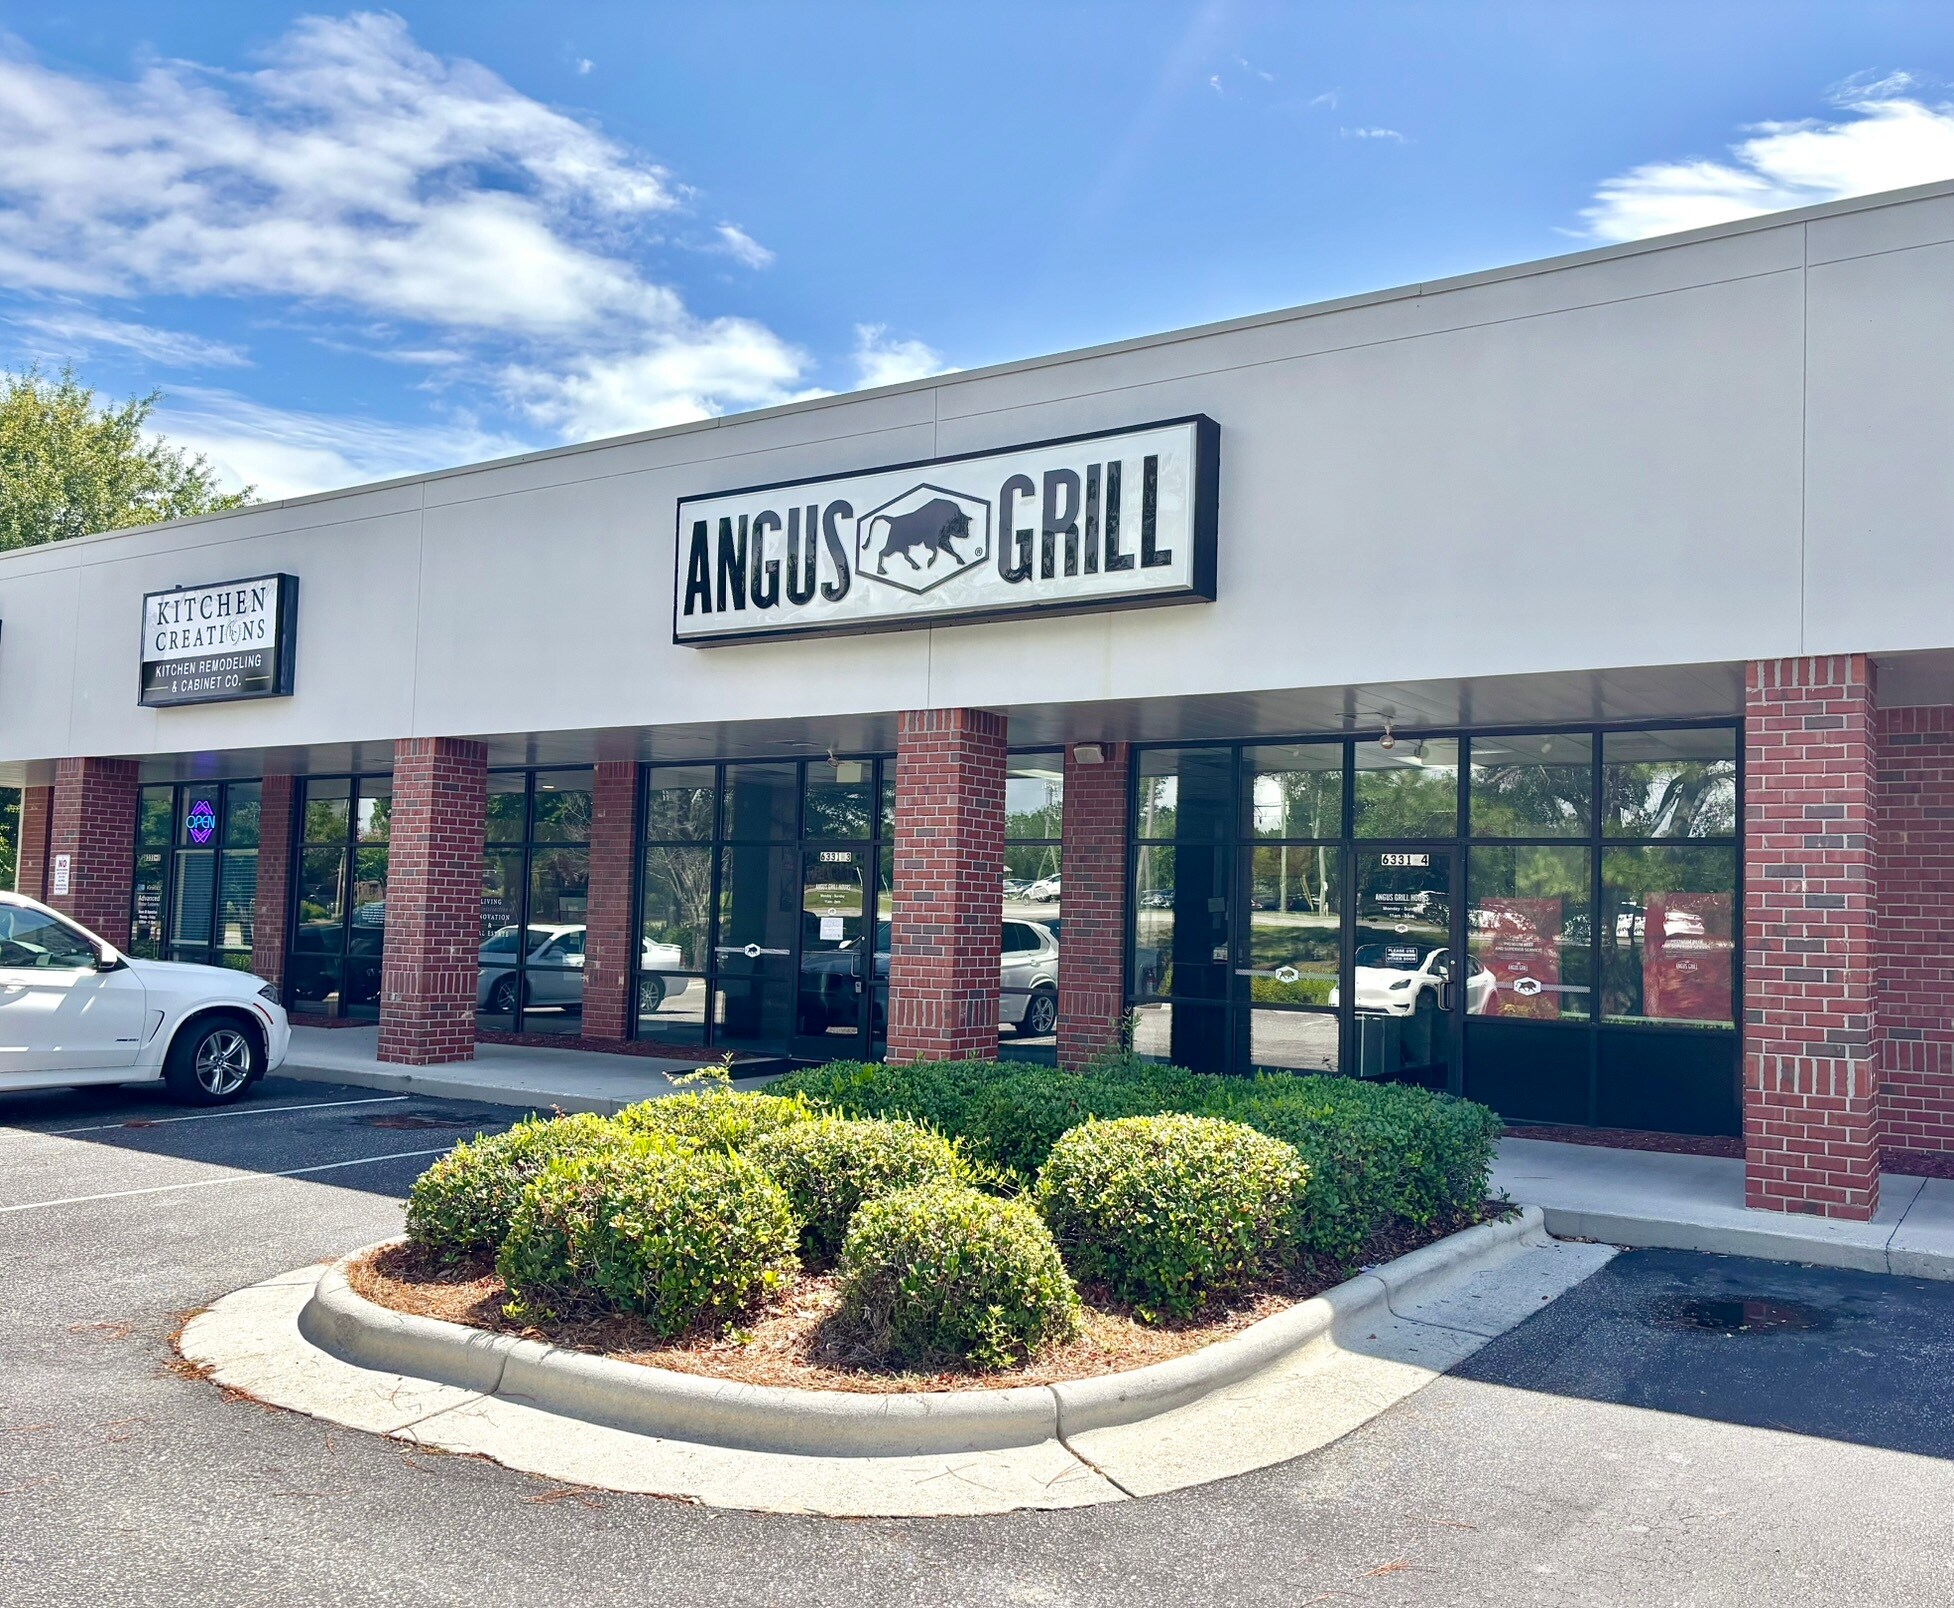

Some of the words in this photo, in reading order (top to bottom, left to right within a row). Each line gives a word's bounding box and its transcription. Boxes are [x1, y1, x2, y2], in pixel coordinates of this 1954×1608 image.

[683, 499, 854, 616] ANGUS
[998, 454, 1172, 584] GRILL
[157, 587, 266, 625] KITCHEN
[155, 662, 195, 677] KITCHEN
[199, 654, 262, 673] REMODELING
[171, 681, 177, 693] &
[181, 676, 222, 692] CABINET
[225, 674, 242, 687] CO.
[186, 815, 215, 829] OPEN
[821, 853, 839, 861] 6331
[1382, 855, 1411, 865] 6331
[1421, 855, 1428, 865] 4
[1375, 893, 1394, 901] ANGUS
